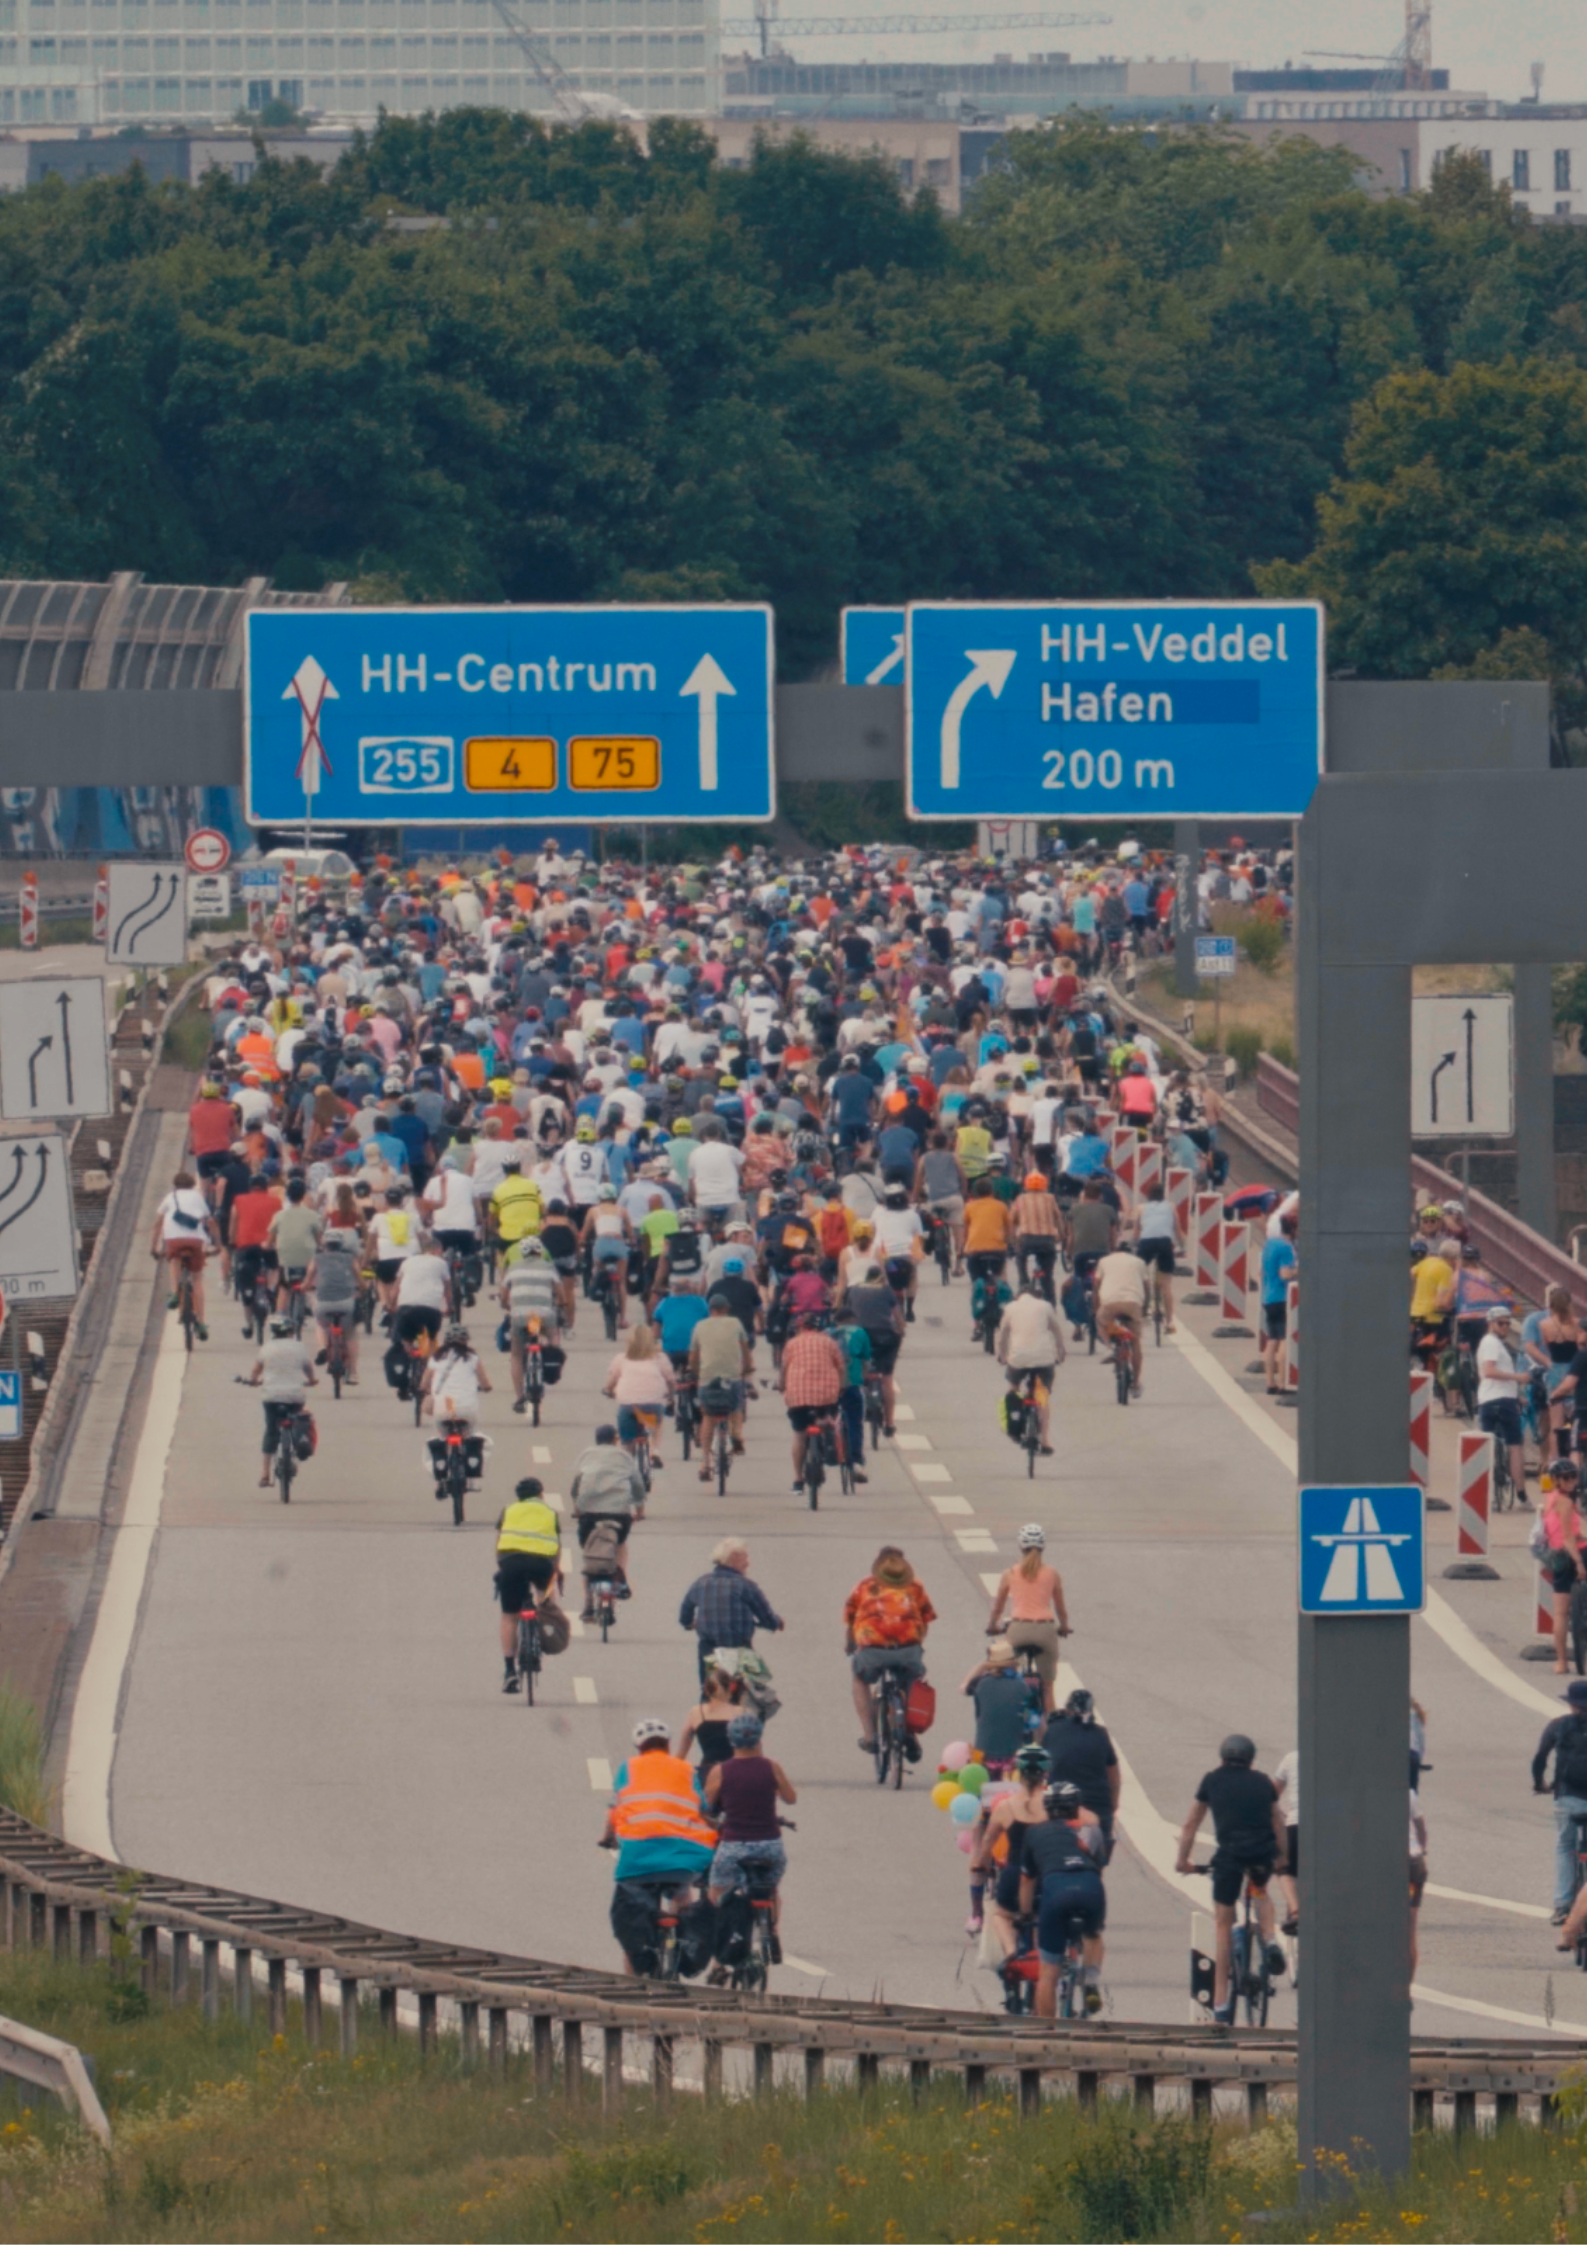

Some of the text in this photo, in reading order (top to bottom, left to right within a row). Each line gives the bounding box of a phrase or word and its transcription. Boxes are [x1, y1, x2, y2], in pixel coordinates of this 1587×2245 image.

[1041, 623, 1288, 662] HH-Veddel
[362, 653, 656, 692] HH-Centrum
[1042, 682, 1172, 722] Hafen
[372, 749, 441, 782] 255
[500, 749, 521, 777] 4
[594, 748, 634, 778] 75
[1042, 750, 1174, 789] 200 m
[580, 1151, 592, 1171] 9
[28, 1280, 46, 1293] m
